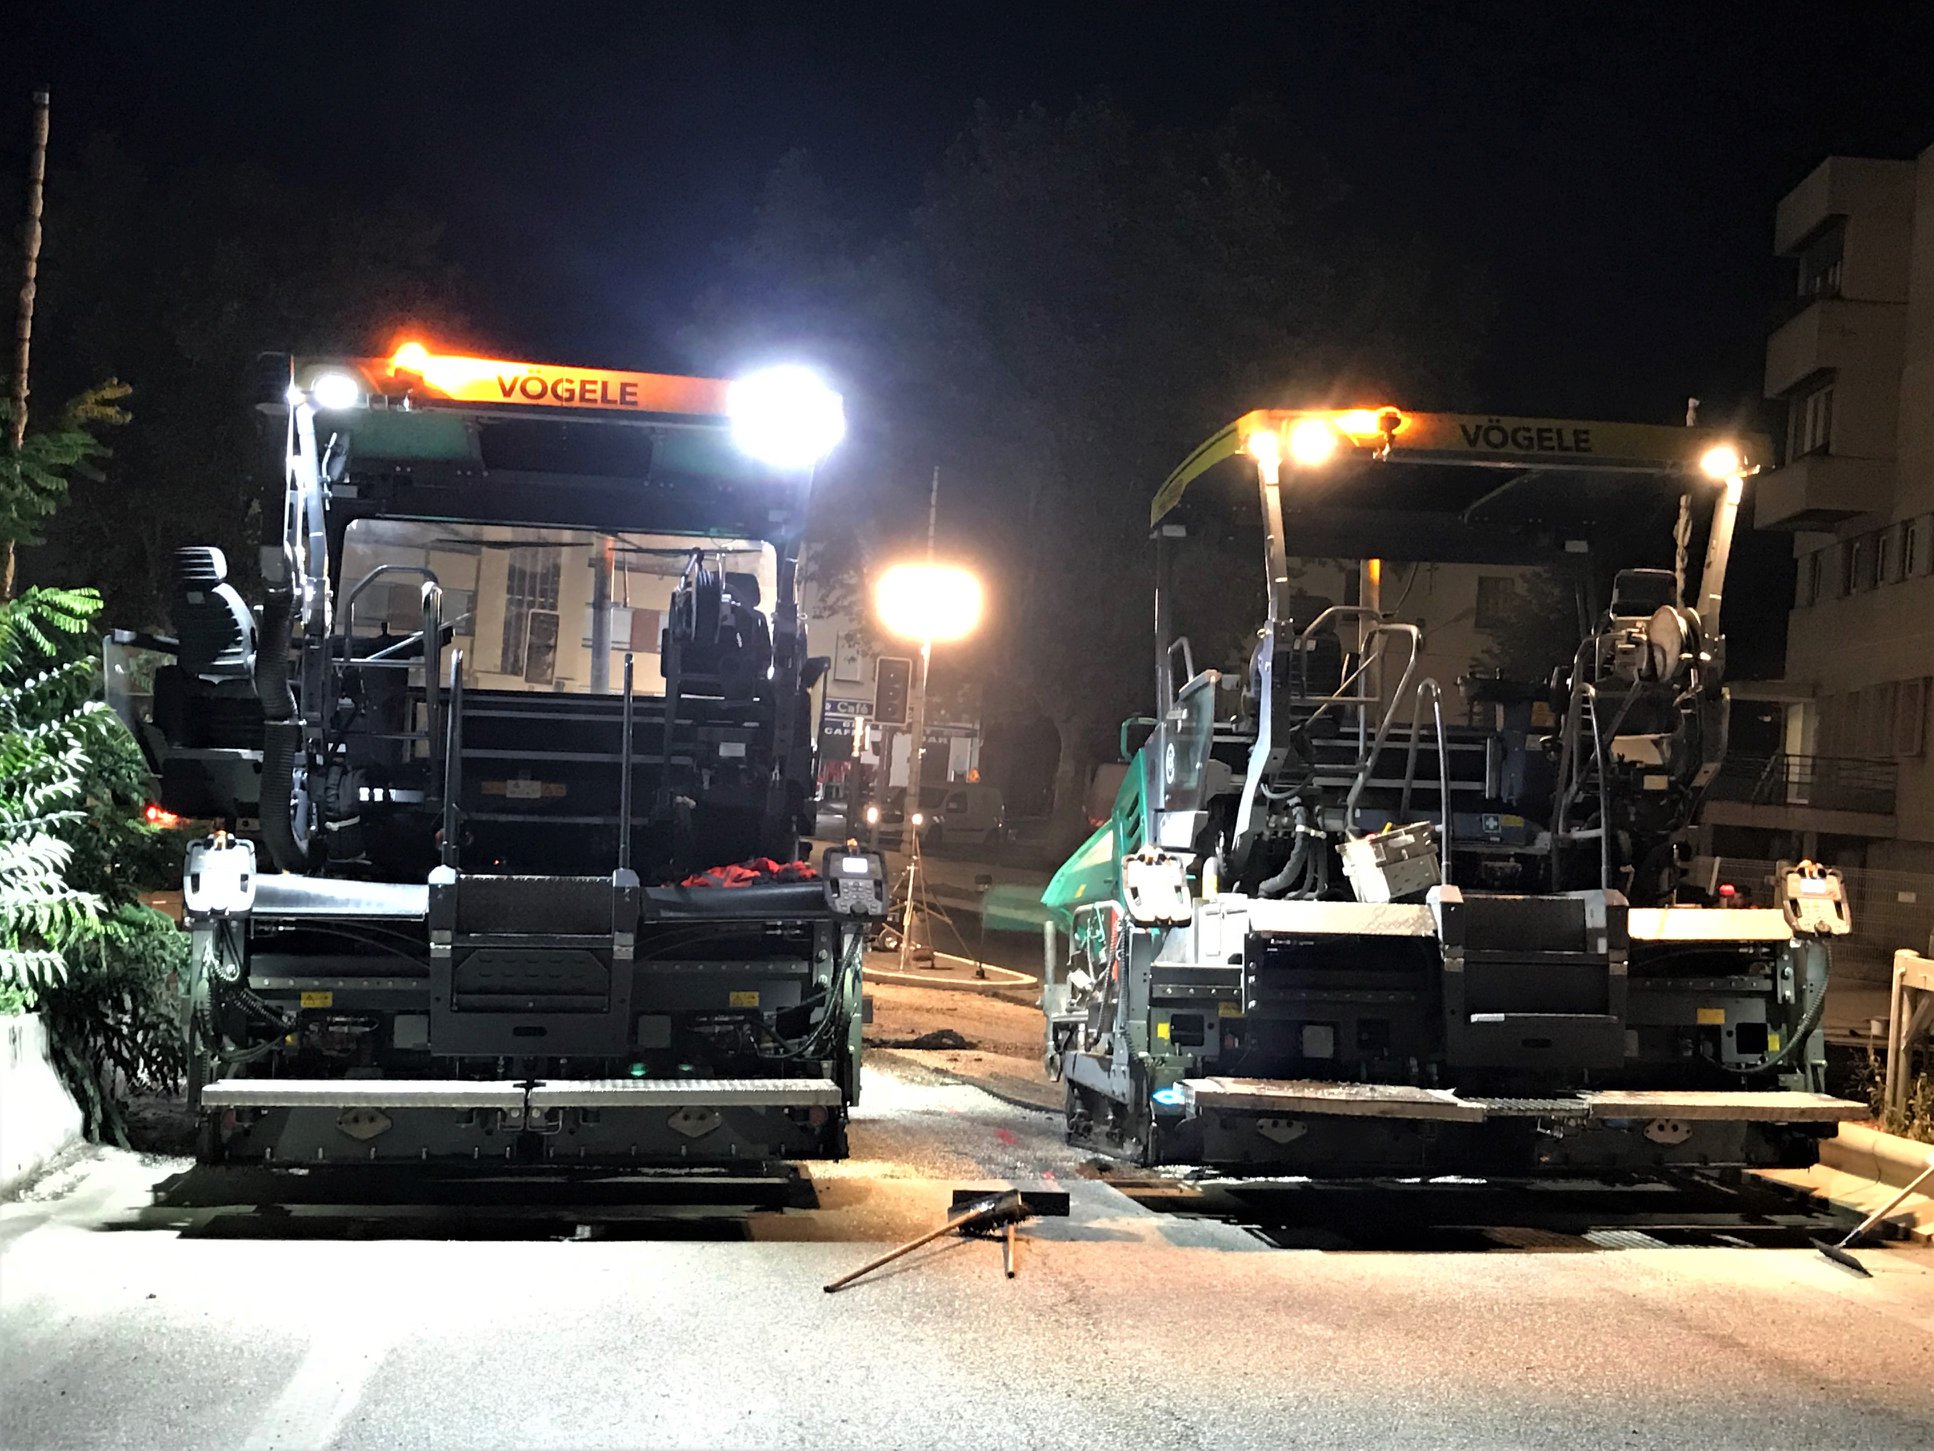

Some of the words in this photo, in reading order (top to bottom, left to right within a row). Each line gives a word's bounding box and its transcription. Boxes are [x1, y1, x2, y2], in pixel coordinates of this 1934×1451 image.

[497, 368, 638, 407] VÖGELE
[1459, 418, 1593, 453] VÖGELE
[837, 702, 868, 715] Café
